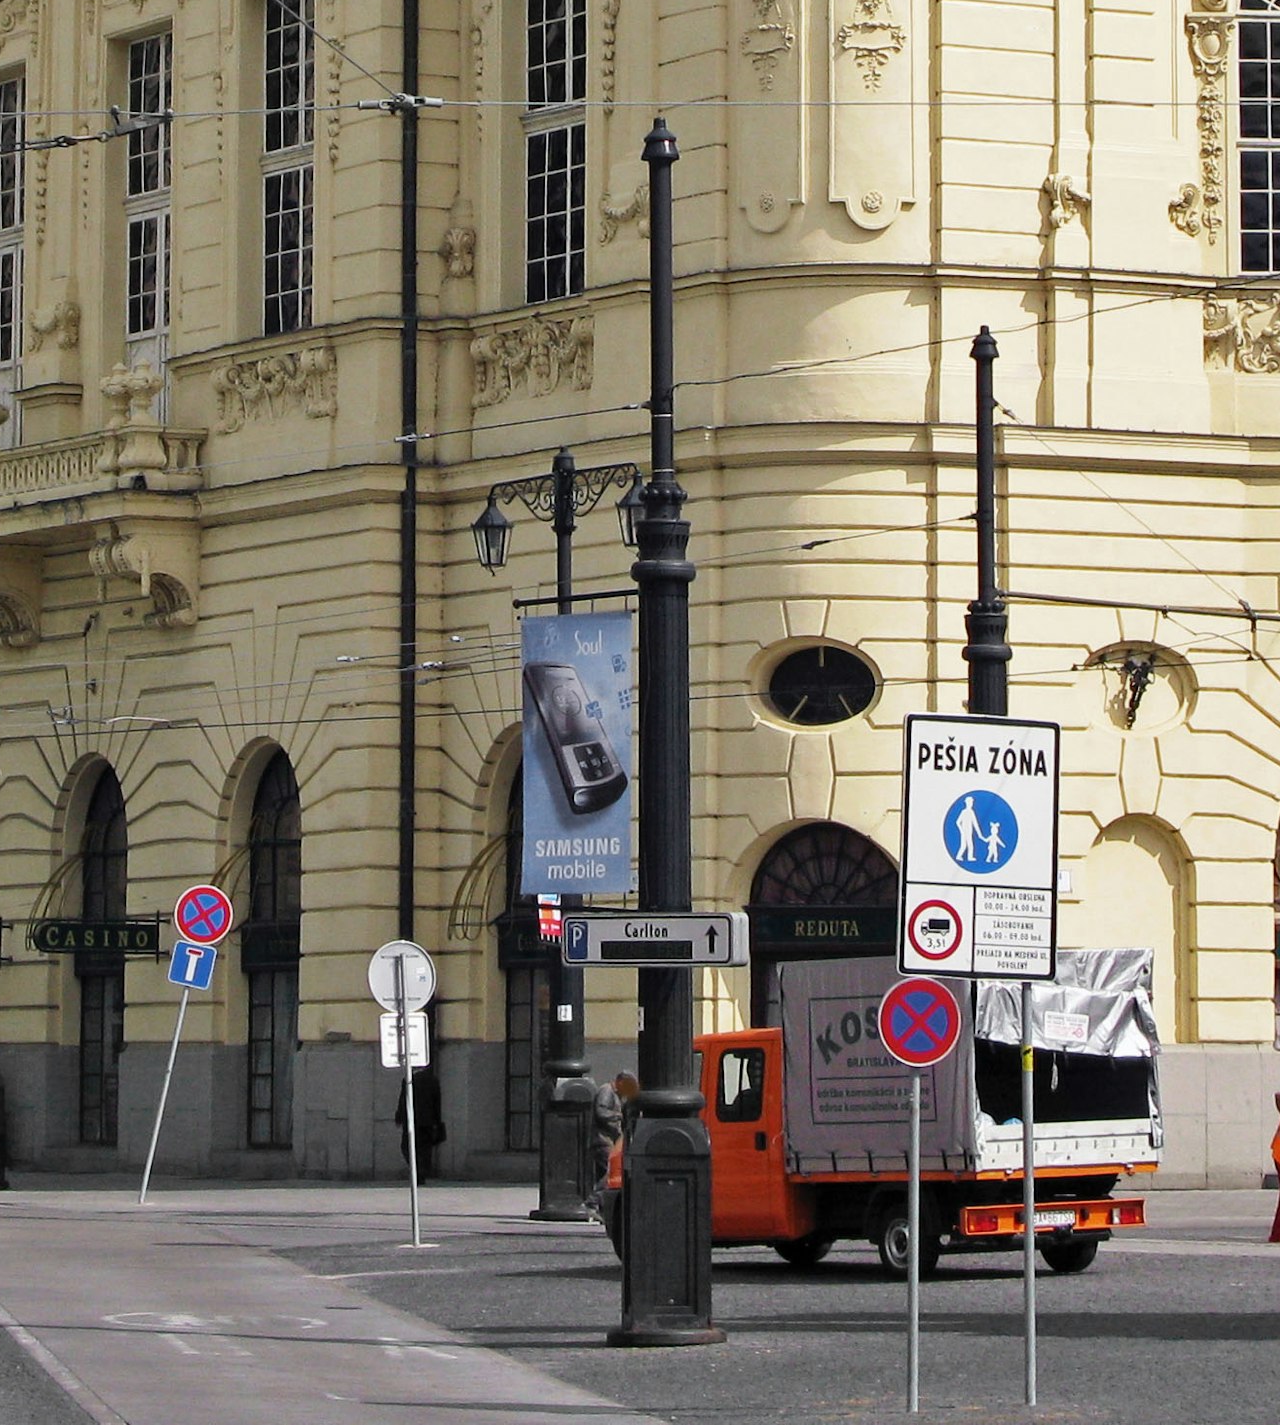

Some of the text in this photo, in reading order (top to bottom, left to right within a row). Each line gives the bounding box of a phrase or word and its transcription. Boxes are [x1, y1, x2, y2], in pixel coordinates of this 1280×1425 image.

[574, 629, 603, 655] Soul
[918, 736, 1048, 777] PEŠIA ZÓNA
[535, 837, 621, 858] SAMSUNG
[548, 860, 607, 880] mobile
[46, 926, 149, 947] CASINO
[624, 922, 668, 938] Carlton
[794, 920, 860, 936] REDUTA
[816, 1006, 880, 1065] KOS
